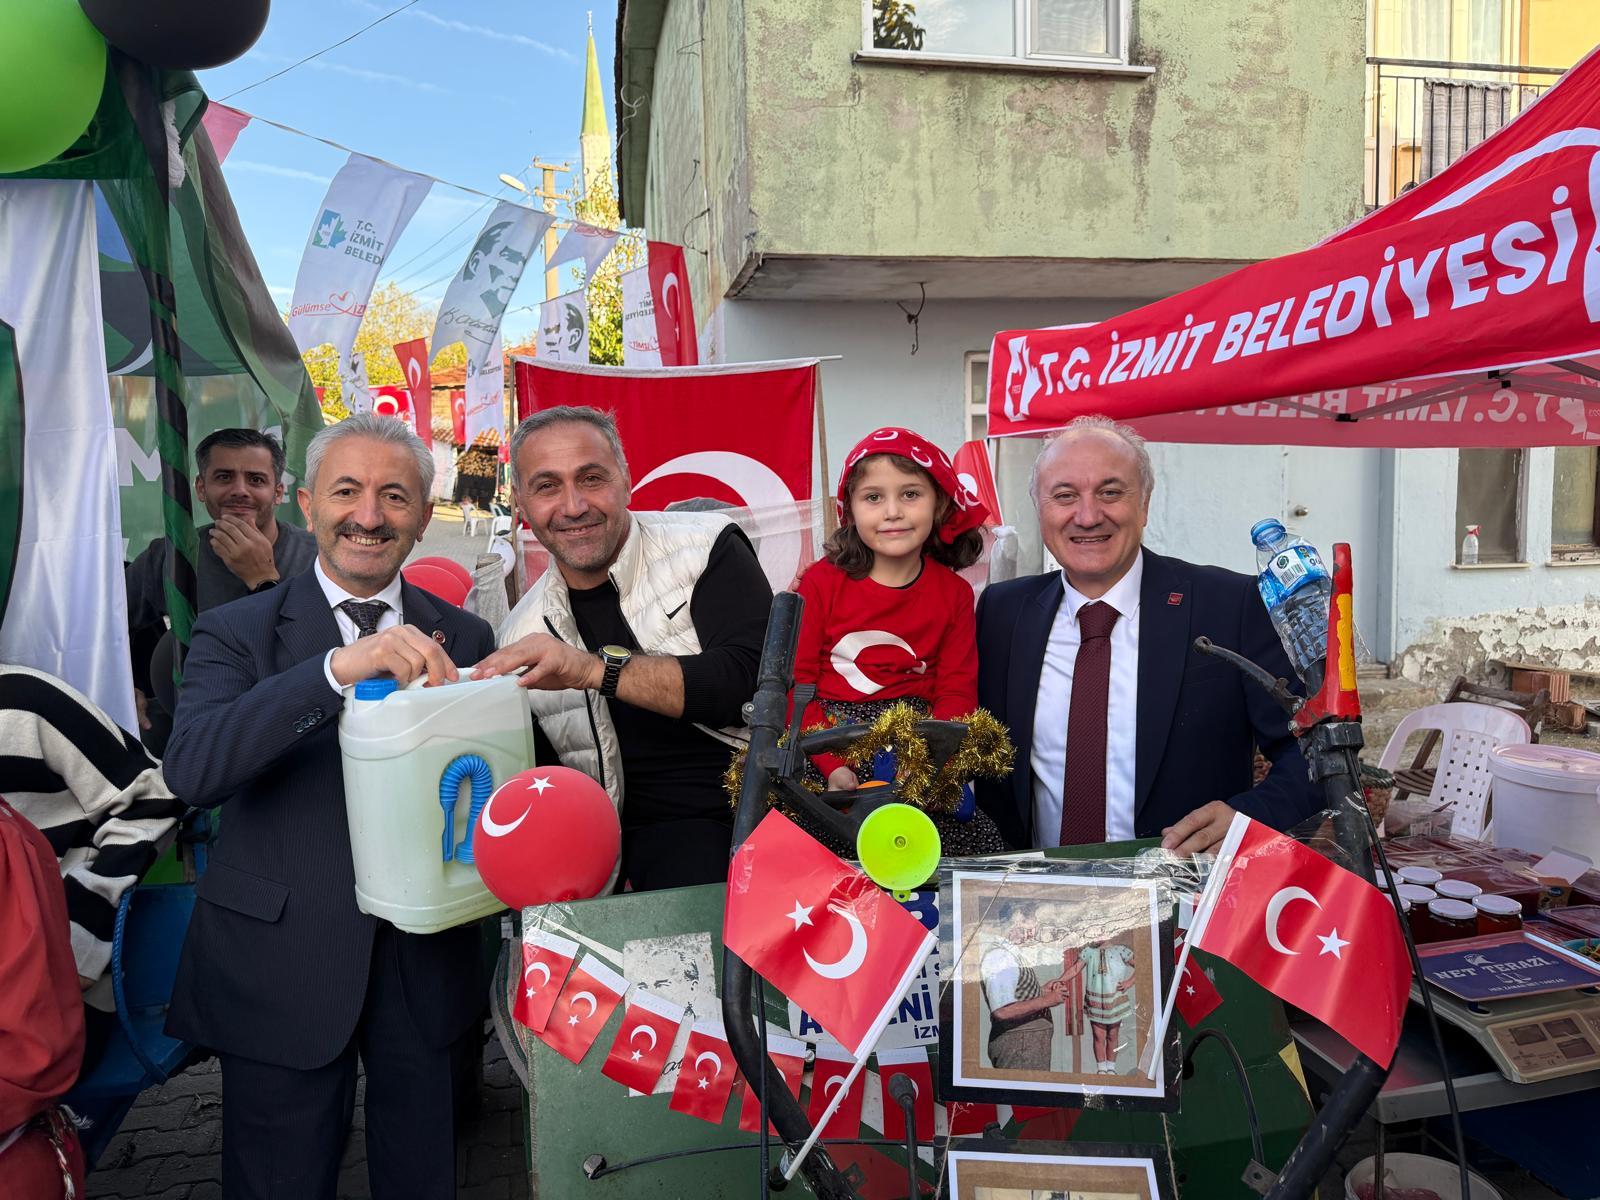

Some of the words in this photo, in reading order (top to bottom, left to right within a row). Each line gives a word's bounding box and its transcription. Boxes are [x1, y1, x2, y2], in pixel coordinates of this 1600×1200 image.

[356, 219, 376, 234] T.C.
[349, 230, 384, 251] İZMİT
[1039, 346, 1091, 396] T.C.
[1098, 312, 1217, 386] İZMİT
[1211, 185, 1578, 365] BELEDİYESİ
[1433, 967, 1477, 980] NET
[1482, 955, 1551, 974] TERAZİ
